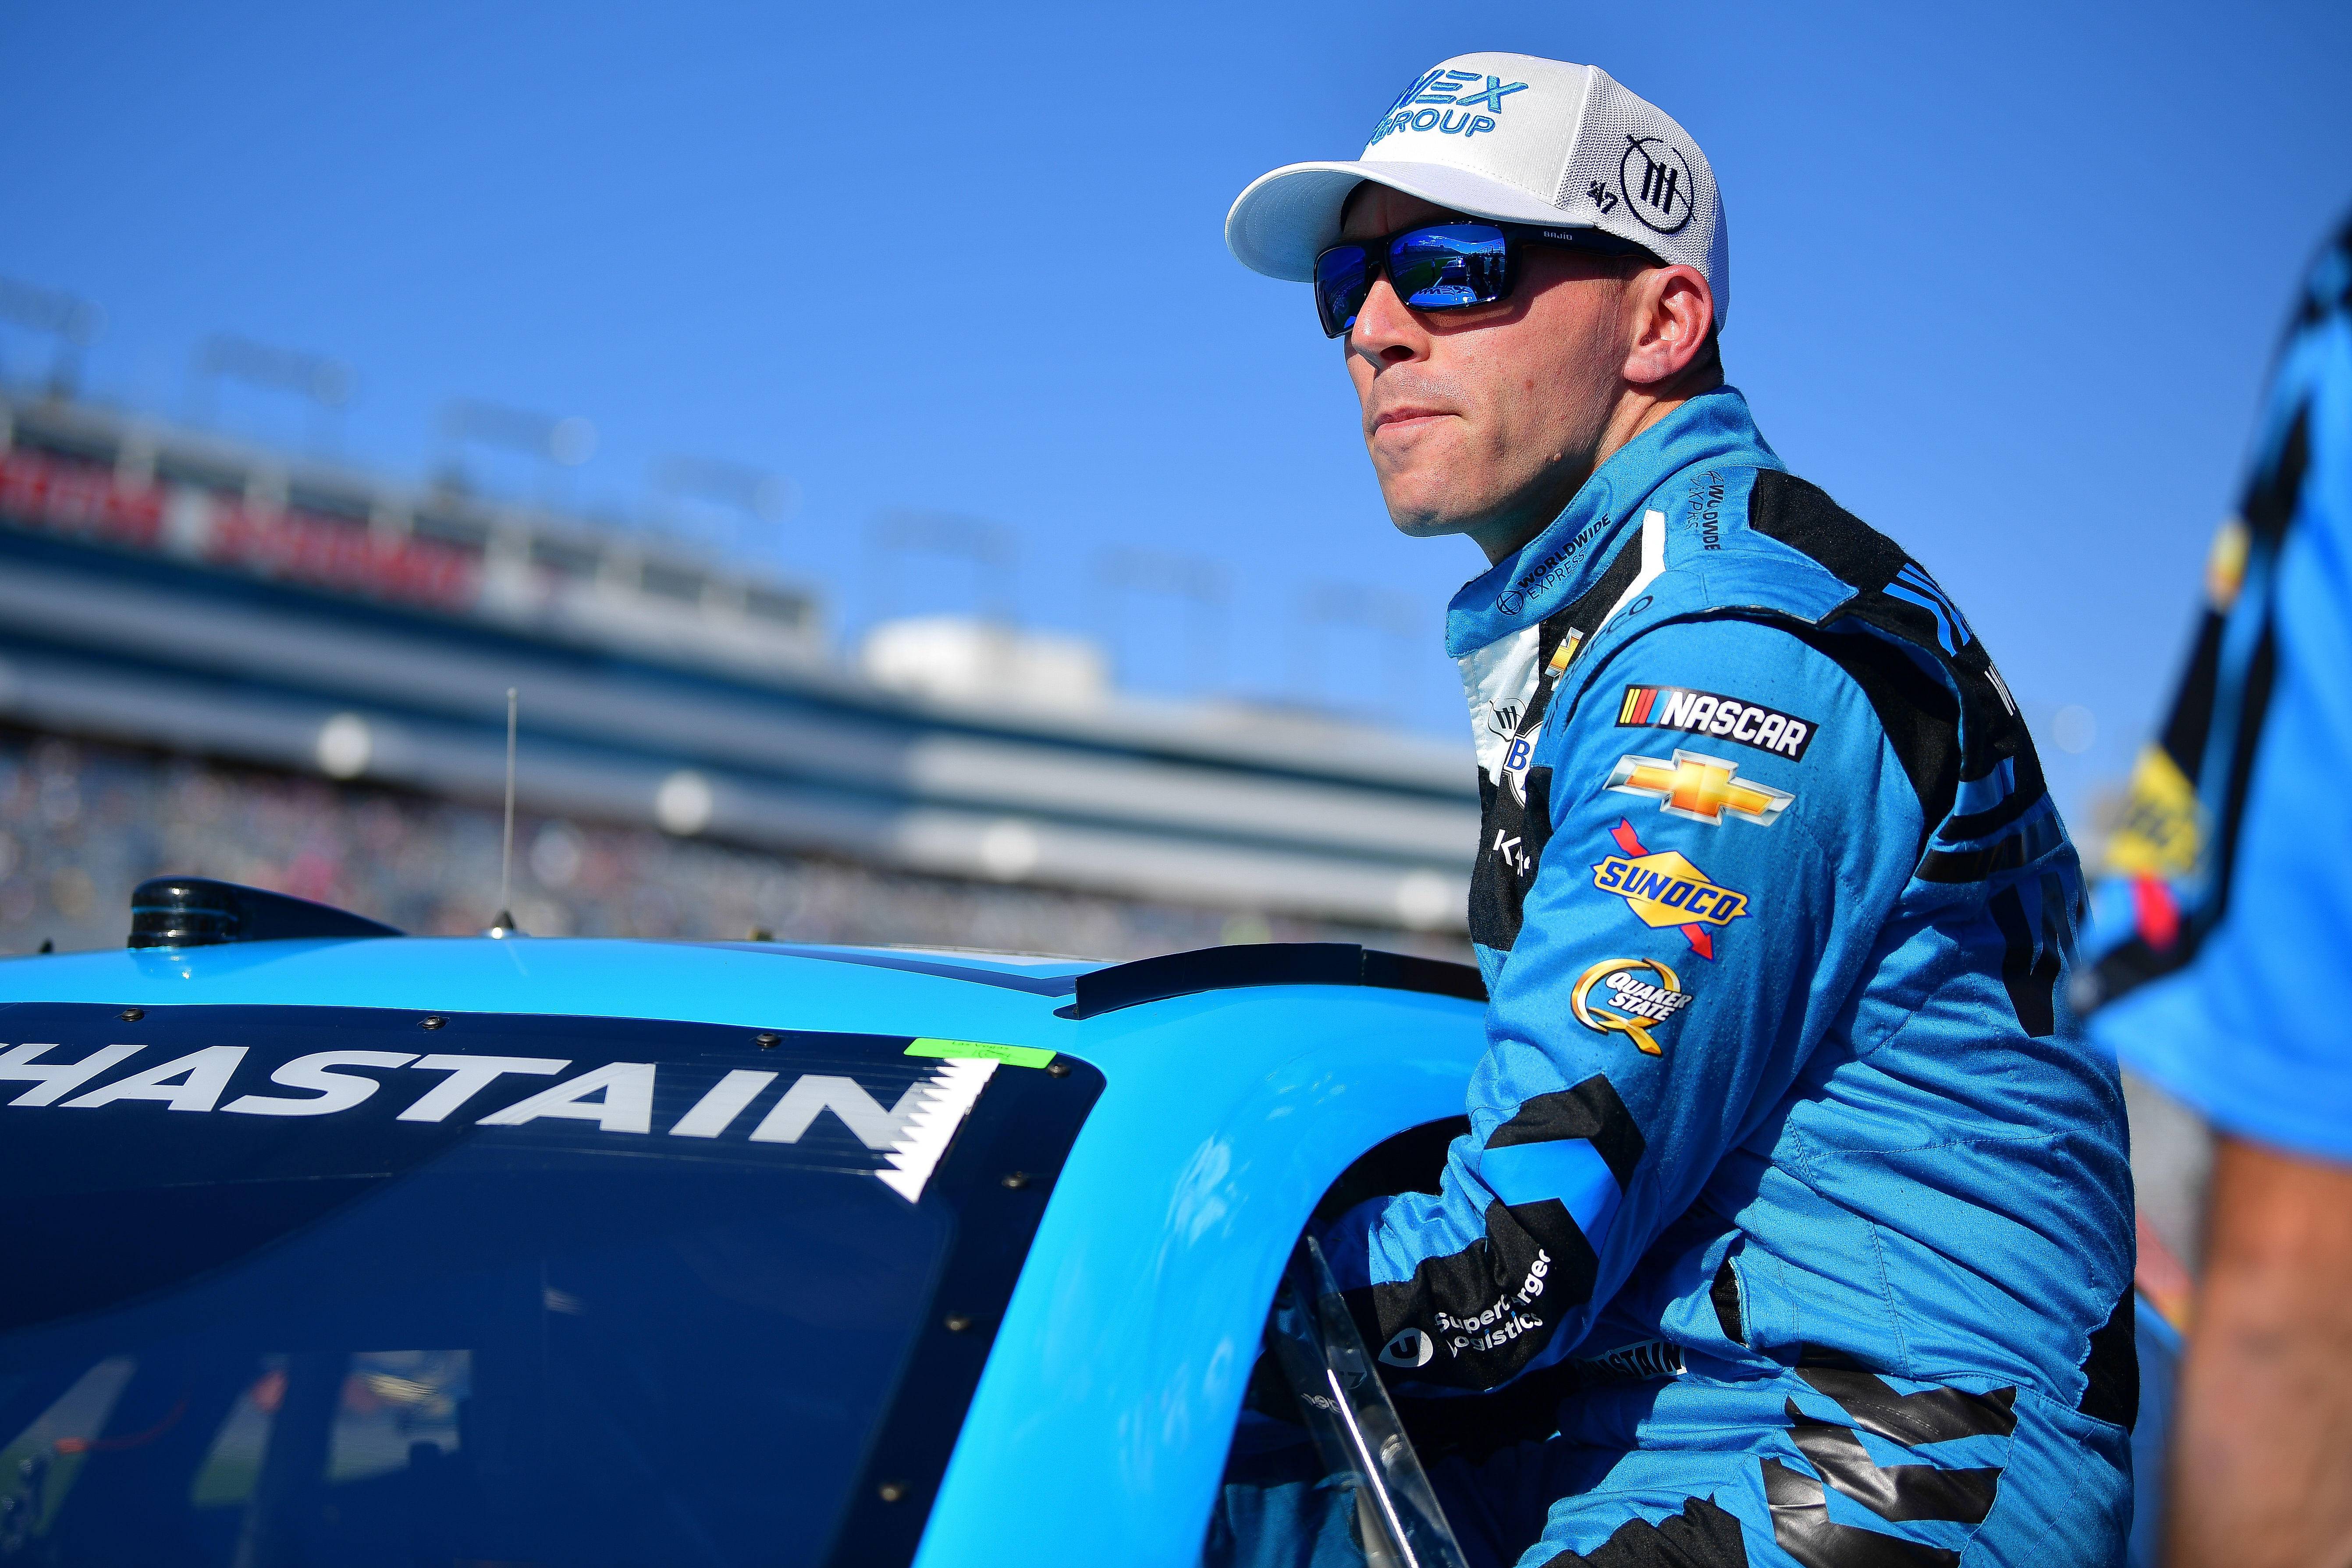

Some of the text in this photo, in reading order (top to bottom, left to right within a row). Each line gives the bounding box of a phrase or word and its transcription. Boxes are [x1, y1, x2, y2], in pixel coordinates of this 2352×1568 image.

[1517, 512, 1611, 588] WORLDWIDE
[1526, 550, 1586, 600] EXPRESS
[1660, 691, 1807, 756] NASCAR
[1599, 861, 1742, 921] SUNOCO
[1606, 971, 1693, 1008] QUAKER
[1608, 992, 1675, 1021] STATE
[0, 1043, 943, 1152] HASTAIN
